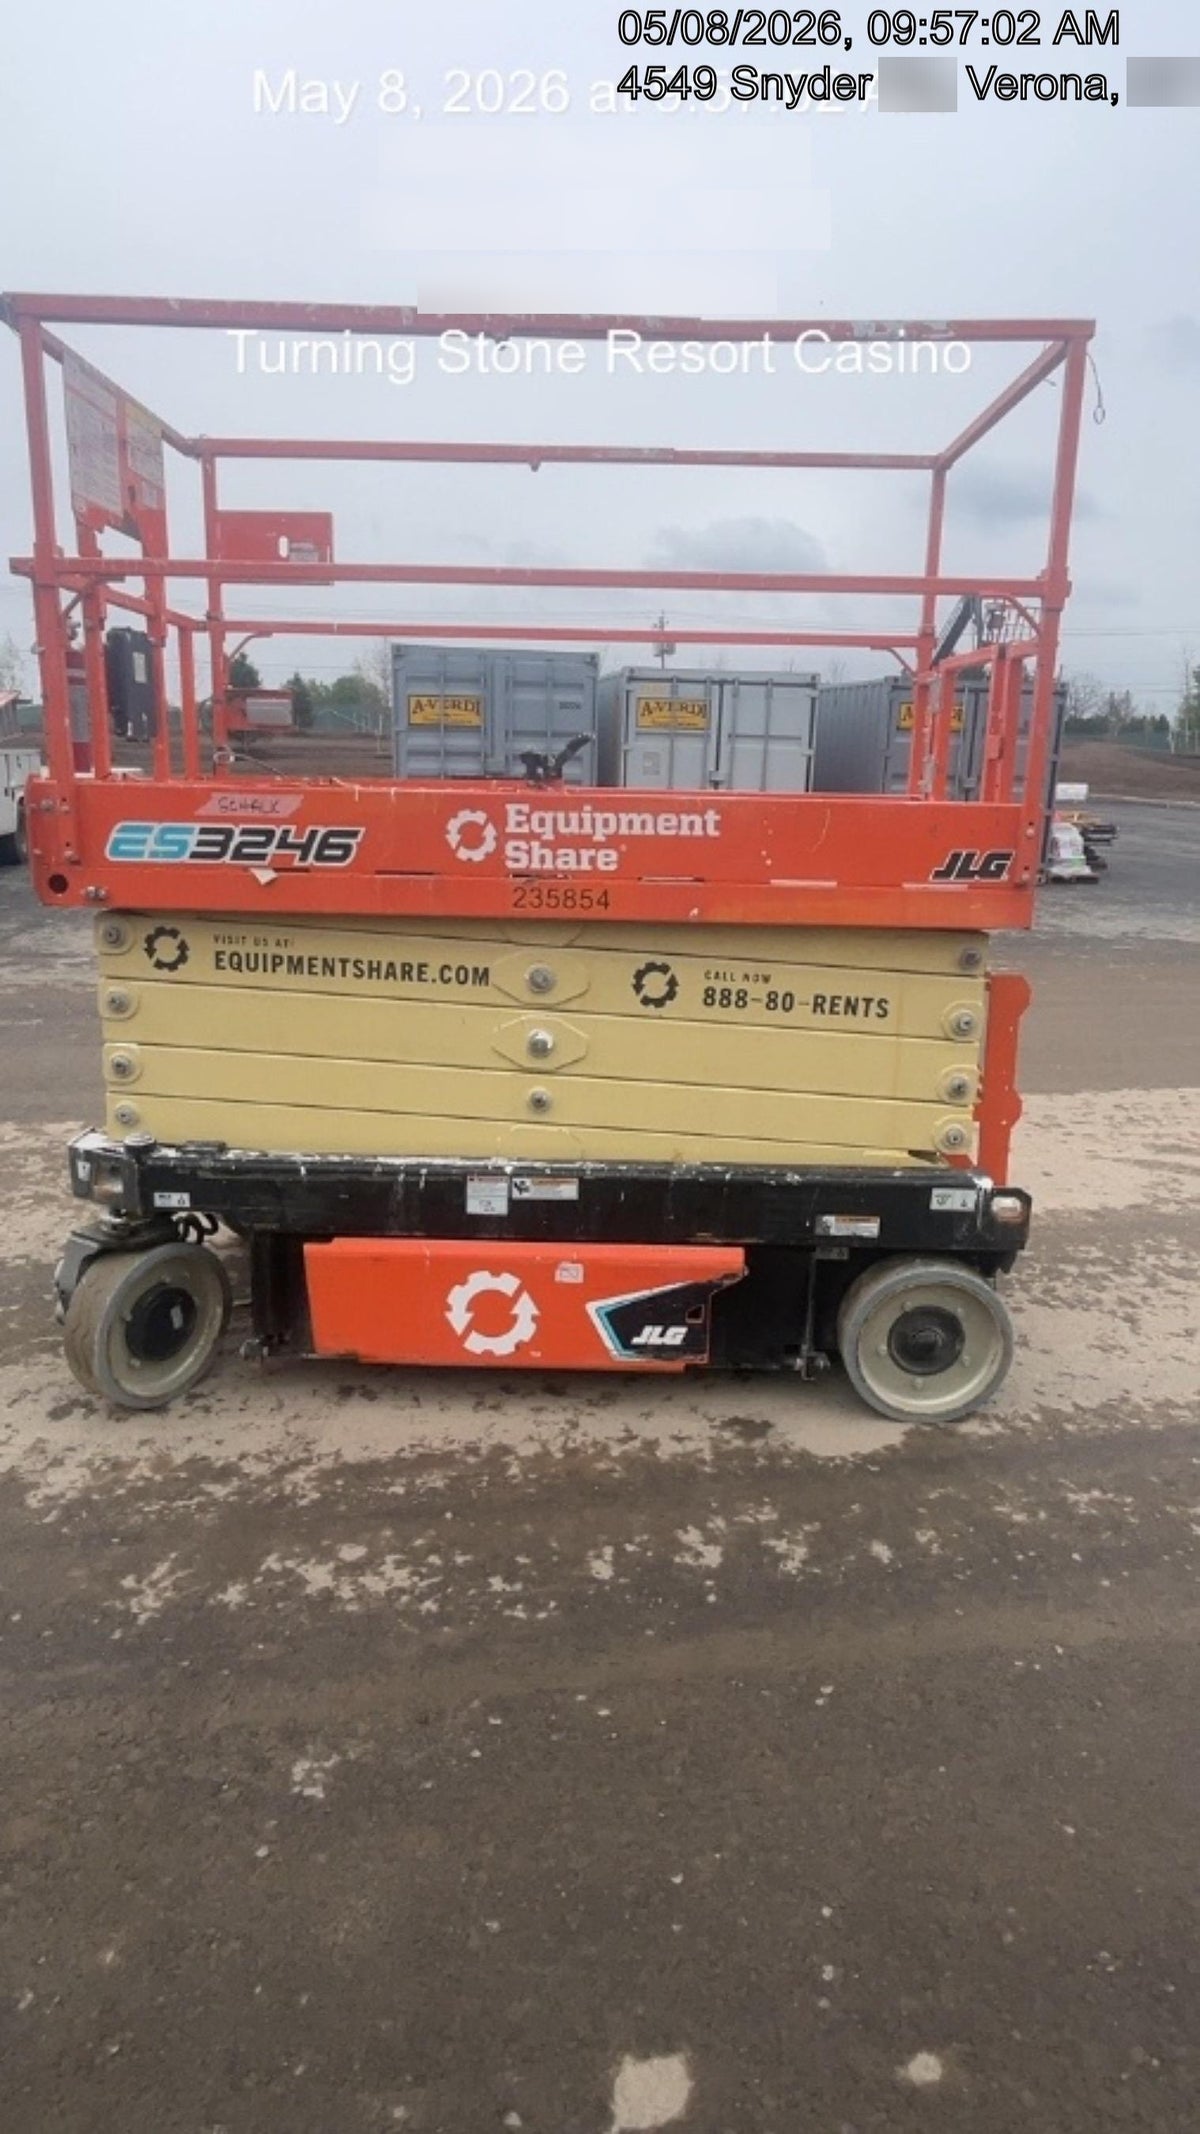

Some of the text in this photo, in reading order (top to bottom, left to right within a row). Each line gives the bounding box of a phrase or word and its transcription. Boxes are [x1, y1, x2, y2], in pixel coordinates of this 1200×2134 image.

[505, 803, 721, 841] Equipment
[106, 822, 364, 865] ES3246
[505, 840, 618, 871] Share
[930, 850, 1014, 880] JLG
[512, 886, 611, 910] 235854
[213, 934, 247, 945] VISIT
[253, 935, 269, 946] US
[214, 950, 490, 986] EQUIPMENTSHARE.COM
[704, 970, 772, 984] CALL NOW
[631, 1325, 688, 1345] JLG
